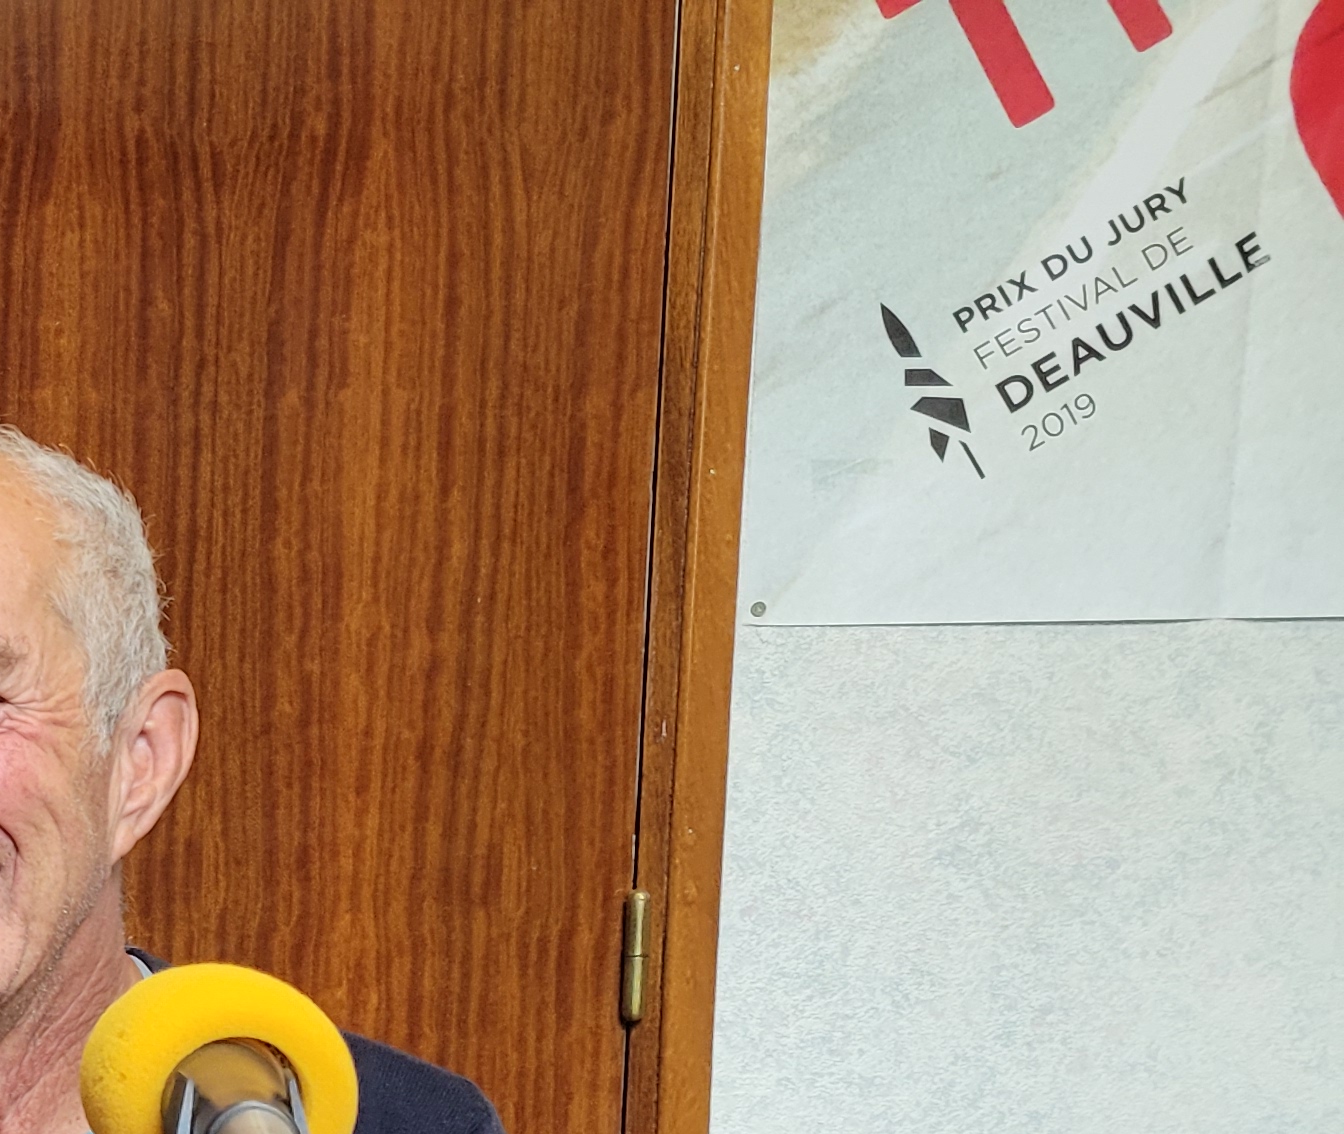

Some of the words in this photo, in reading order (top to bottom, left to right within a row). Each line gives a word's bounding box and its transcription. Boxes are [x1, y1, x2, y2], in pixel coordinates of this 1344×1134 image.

[952, 270, 1038, 333] PRIX
[1041, 236, 1093, 282] DU
[1107, 176, 1189, 247] JURY
[973, 266, 1138, 370] FESTIVAL
[1141, 226, 1194, 271] DE
[995, 231, 1270, 414] DEAUVILLE
[1020, 393, 1097, 452] 2019
